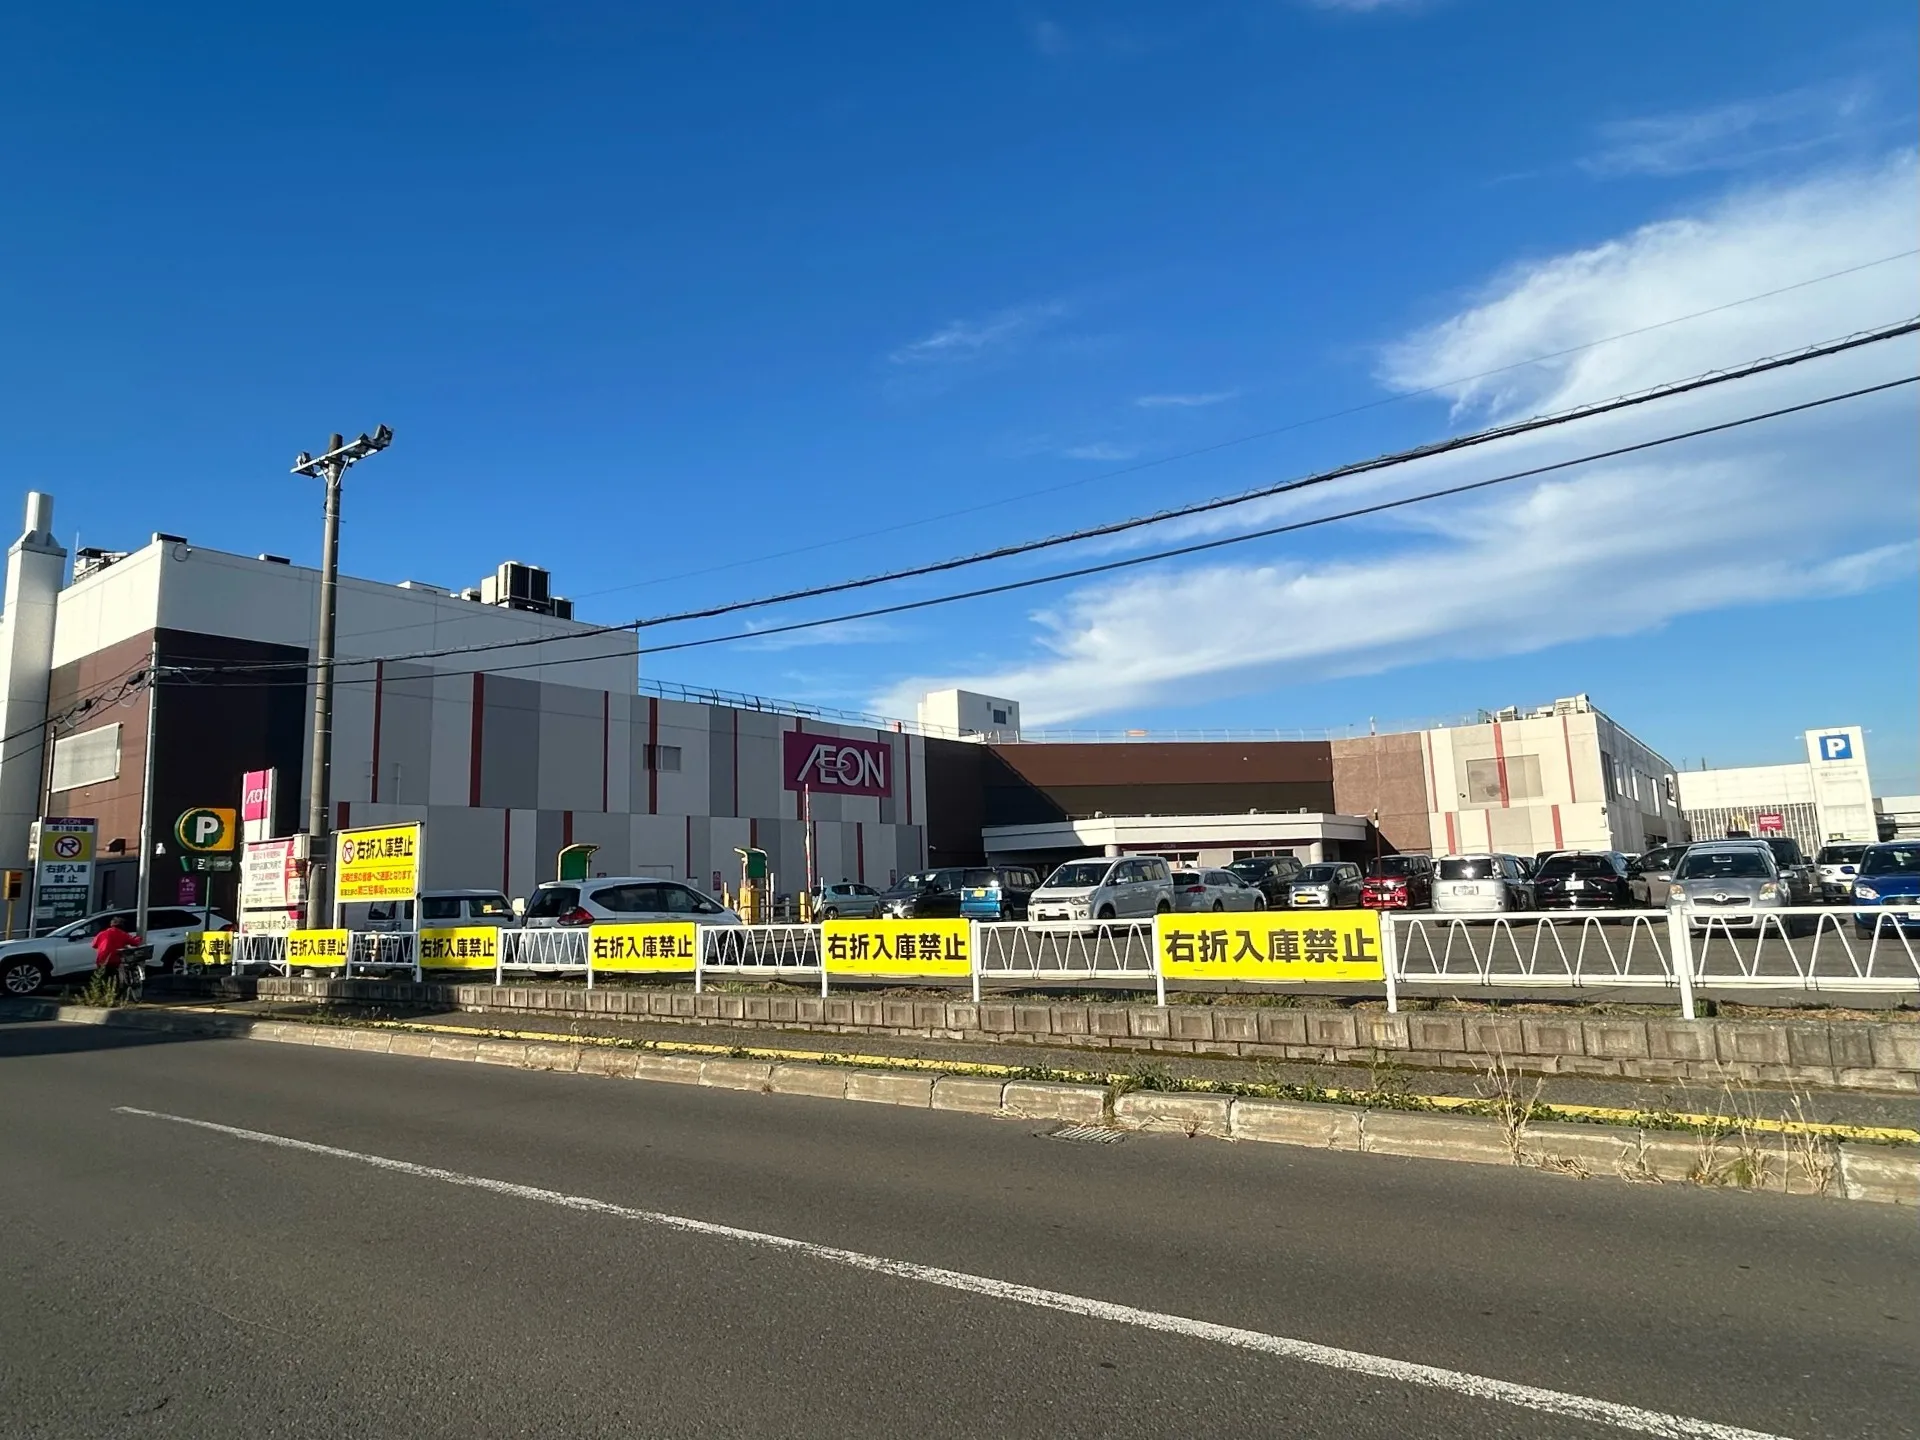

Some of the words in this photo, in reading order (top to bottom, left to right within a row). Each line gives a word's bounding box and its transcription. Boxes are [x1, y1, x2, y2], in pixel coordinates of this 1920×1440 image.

[1826, 738, 1846, 758] P
[195, 816, 219, 843] P
[357, 835, 413, 860] 右折入庫禁止
[45, 864, 87, 873] 右折入庫
[53, 874, 78, 883] 禁止
[187, 937, 231, 956] 右折入庫禁止
[290, 938, 346, 956] 右折入庫禁止
[421, 937, 495, 958] 右折入庫禁止
[594, 934, 693, 959] 右折入庫禁止
[827, 933, 967, 960] 右折入庫禁止
[1164, 928, 1378, 963] 右折入庫禁止
